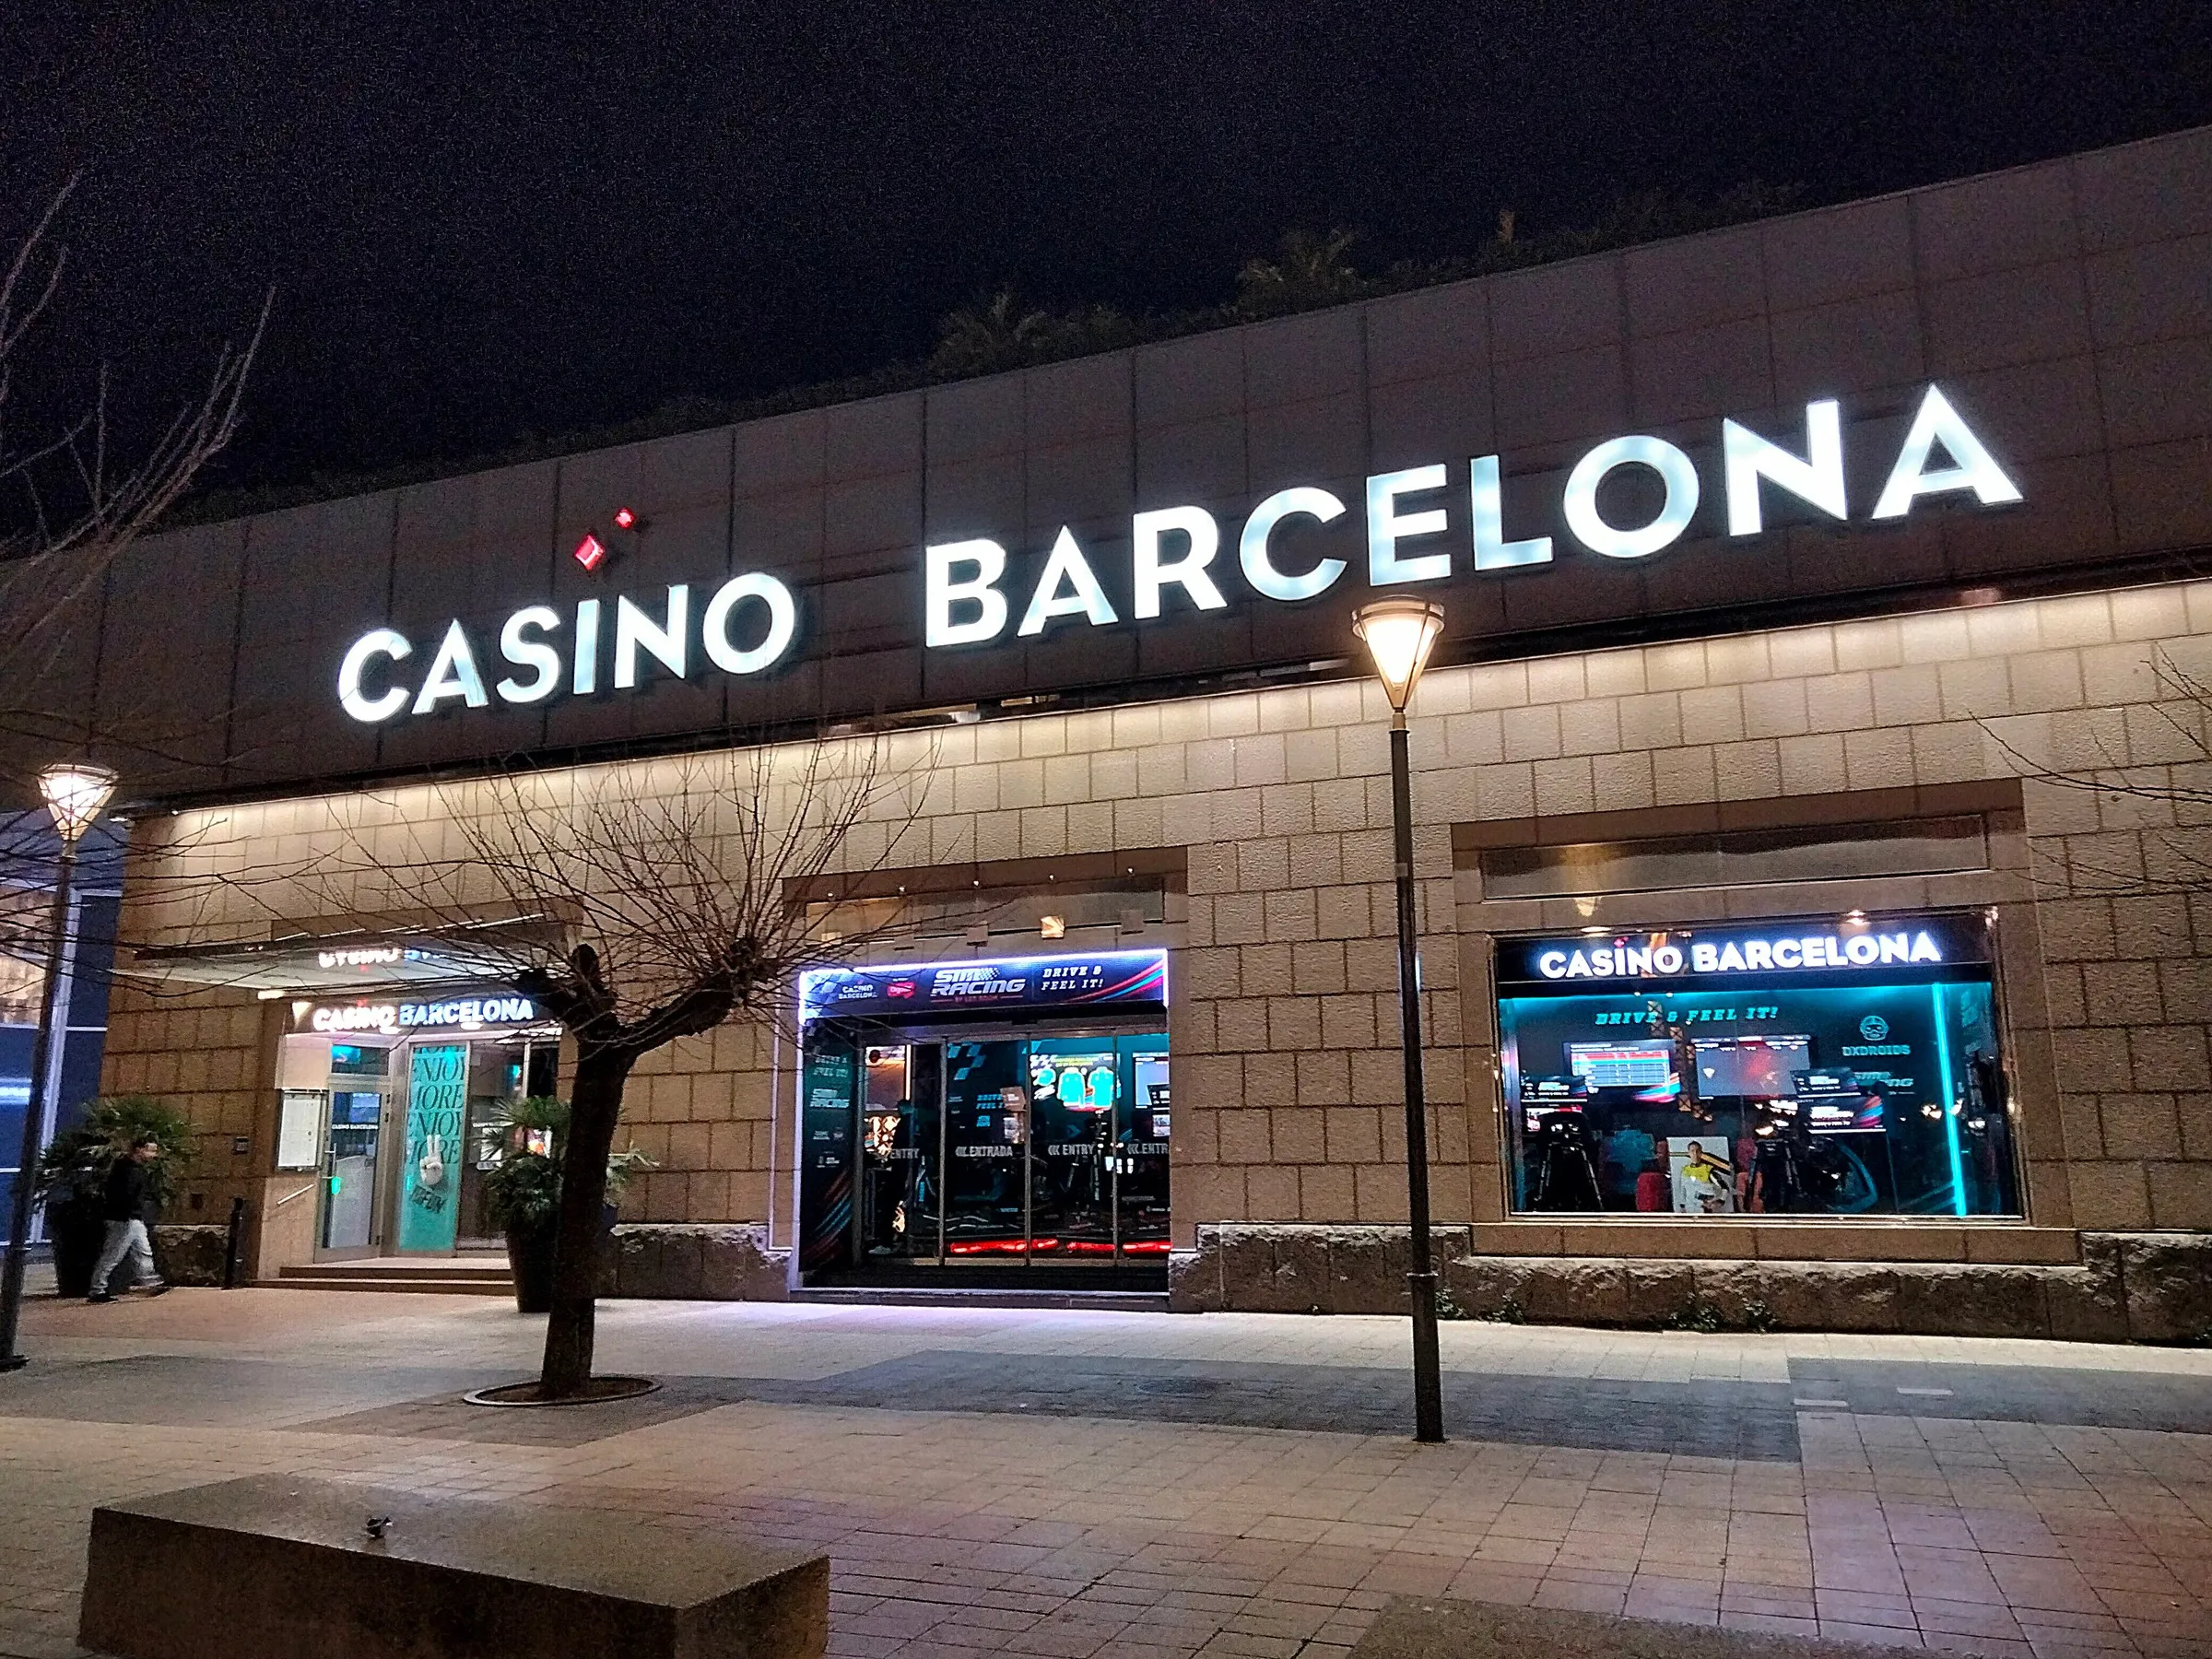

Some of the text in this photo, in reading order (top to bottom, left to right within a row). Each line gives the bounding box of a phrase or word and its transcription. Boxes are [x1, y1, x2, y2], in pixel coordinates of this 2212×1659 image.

[338, 383, 2024, 723] CASINO BARCELONA
[1539, 932, 1942, 979] CASINO BARCELONA
[1042, 966, 1088, 978] DRIVE
[931, 979, 1026, 997] RACING
[1041, 978, 1104, 991] FEEL IT!
[312, 997, 535, 1031] CASINO BARCELONA
[1595, 1013, 1658, 1026] DRIVE
[1688, 1007, 1737, 1022] FEEL
[1746, 1006, 1779, 1020] IT!
[969, 1146, 1014, 1158] ENTRADA
[1063, 1143, 1094, 1156] ENTRY
